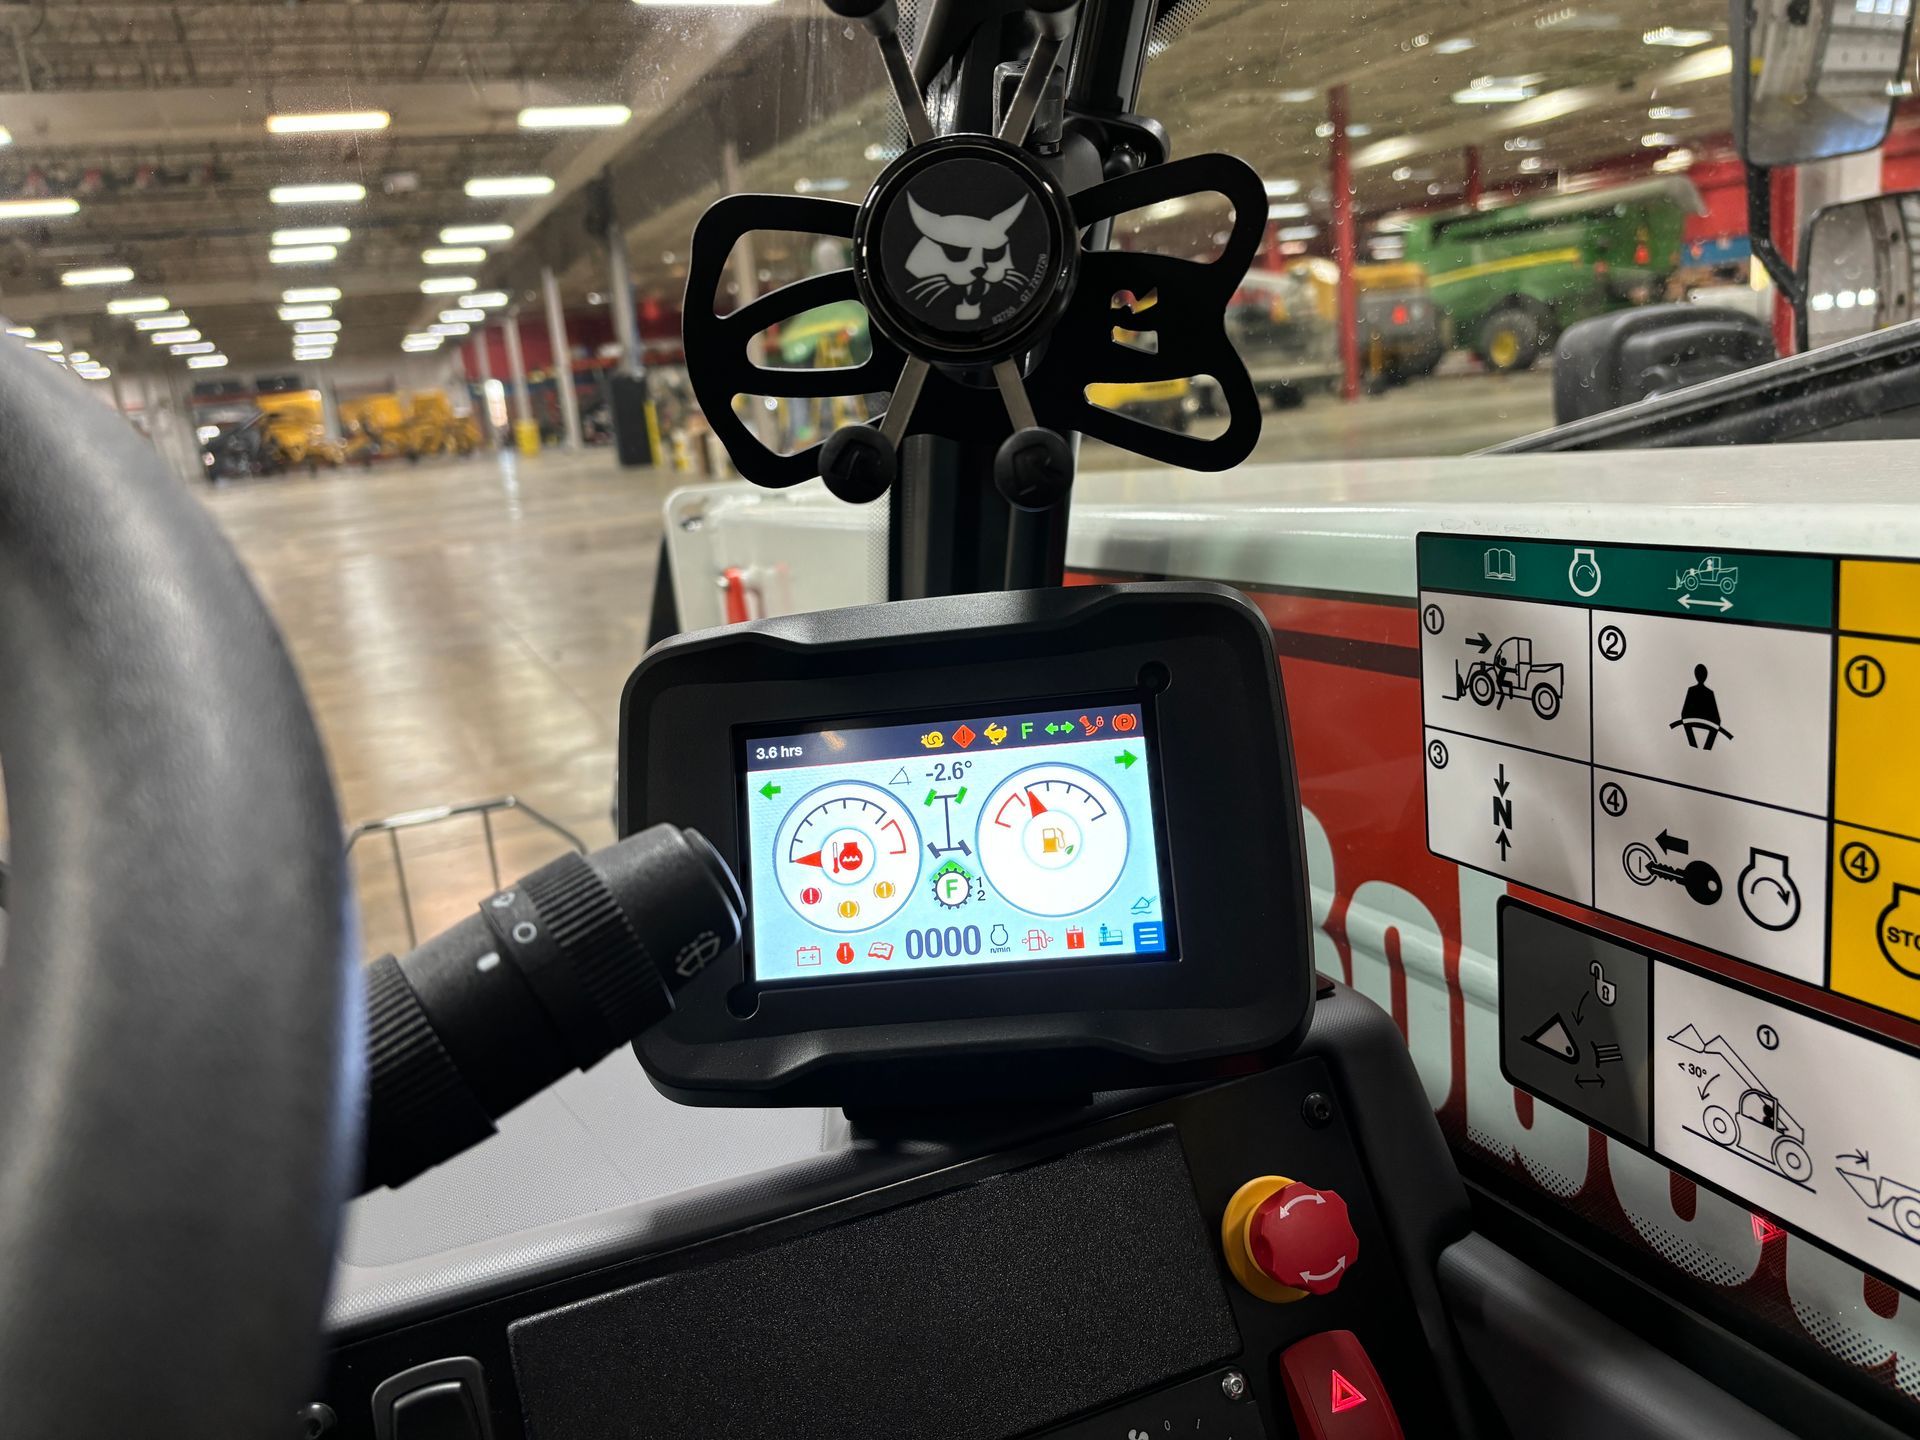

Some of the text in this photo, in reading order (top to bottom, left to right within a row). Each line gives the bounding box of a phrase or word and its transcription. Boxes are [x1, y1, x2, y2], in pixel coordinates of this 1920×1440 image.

[1021, 722, 1033, 740] F
[756, 745, 803, 760] 3.6 hrs
[925, 760, 973, 782] -2.6°
[1492, 795, 1513, 831] N
[945, 878, 959, 899] F
[976, 876, 983, 888] 1
[977, 890, 986, 902] 2
[905, 924, 982, 960] 0000
